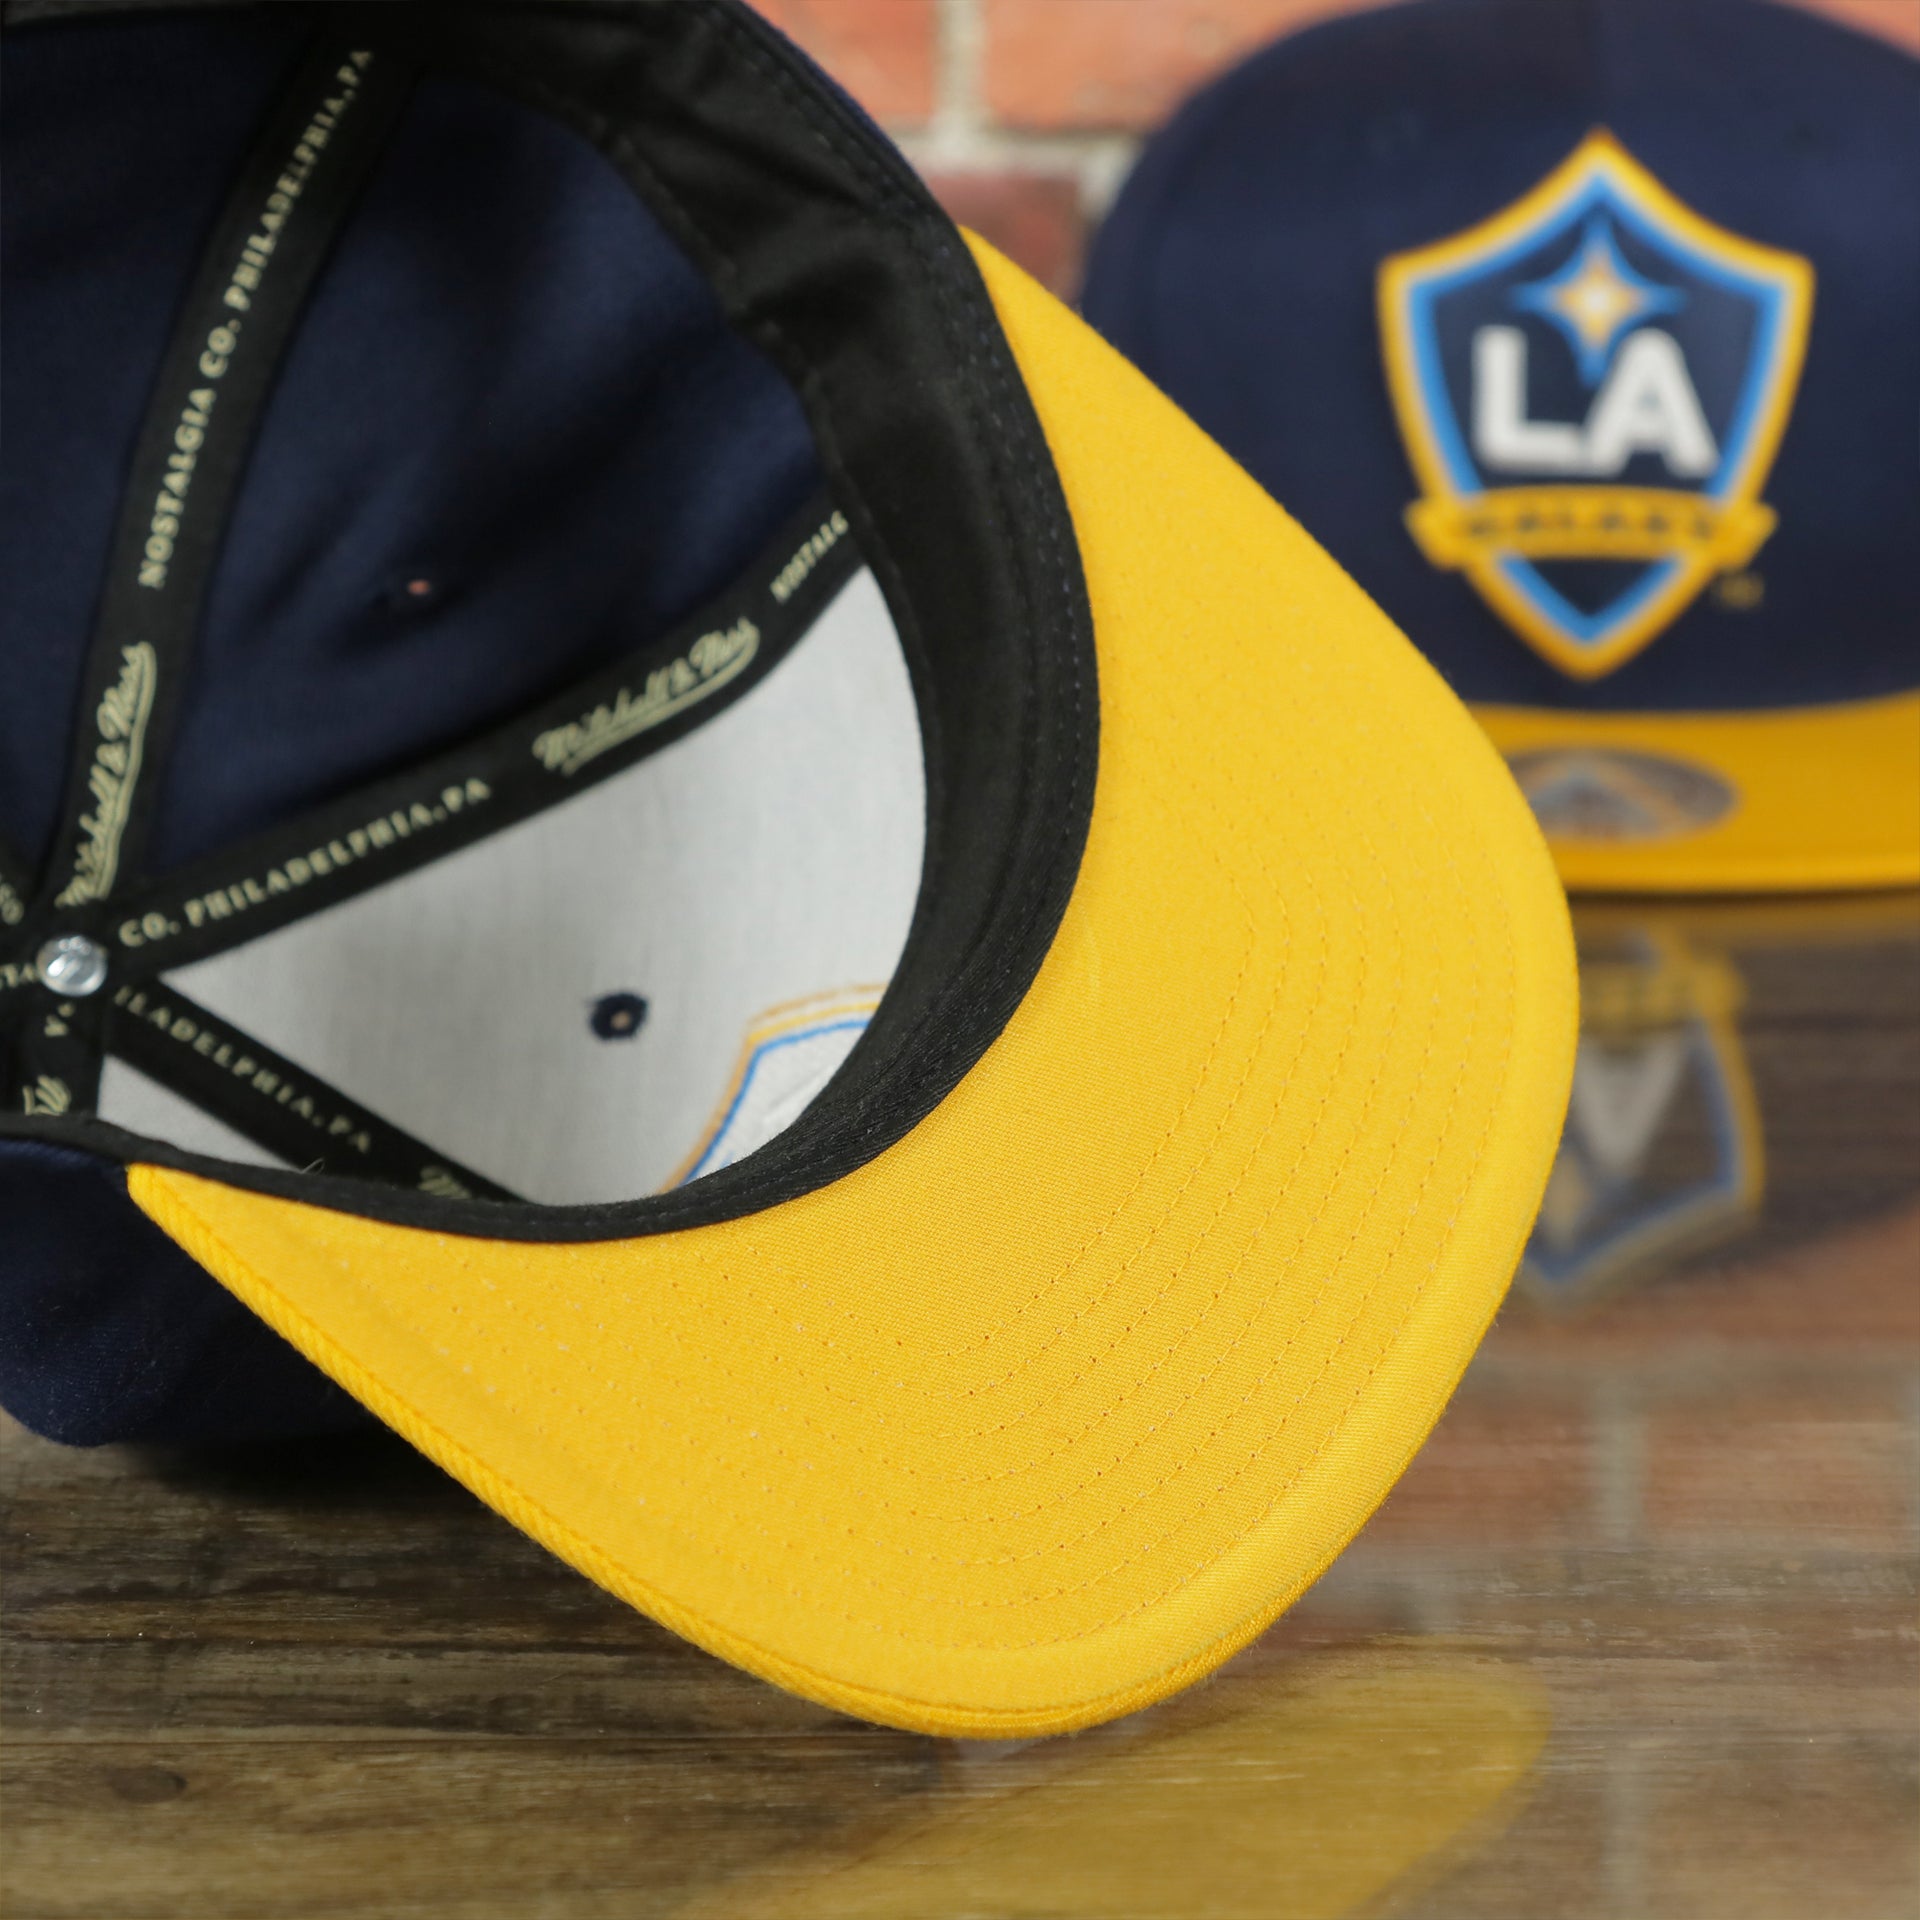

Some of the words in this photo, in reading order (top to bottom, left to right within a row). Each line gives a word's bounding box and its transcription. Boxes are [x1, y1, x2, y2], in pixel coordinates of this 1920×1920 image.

[138, 388, 217, 590] NOSTALGIA
[199, 318, 242, 379] CO.
[1471, 323, 1723, 478] LA
[119, 911, 182, 948] CO.
